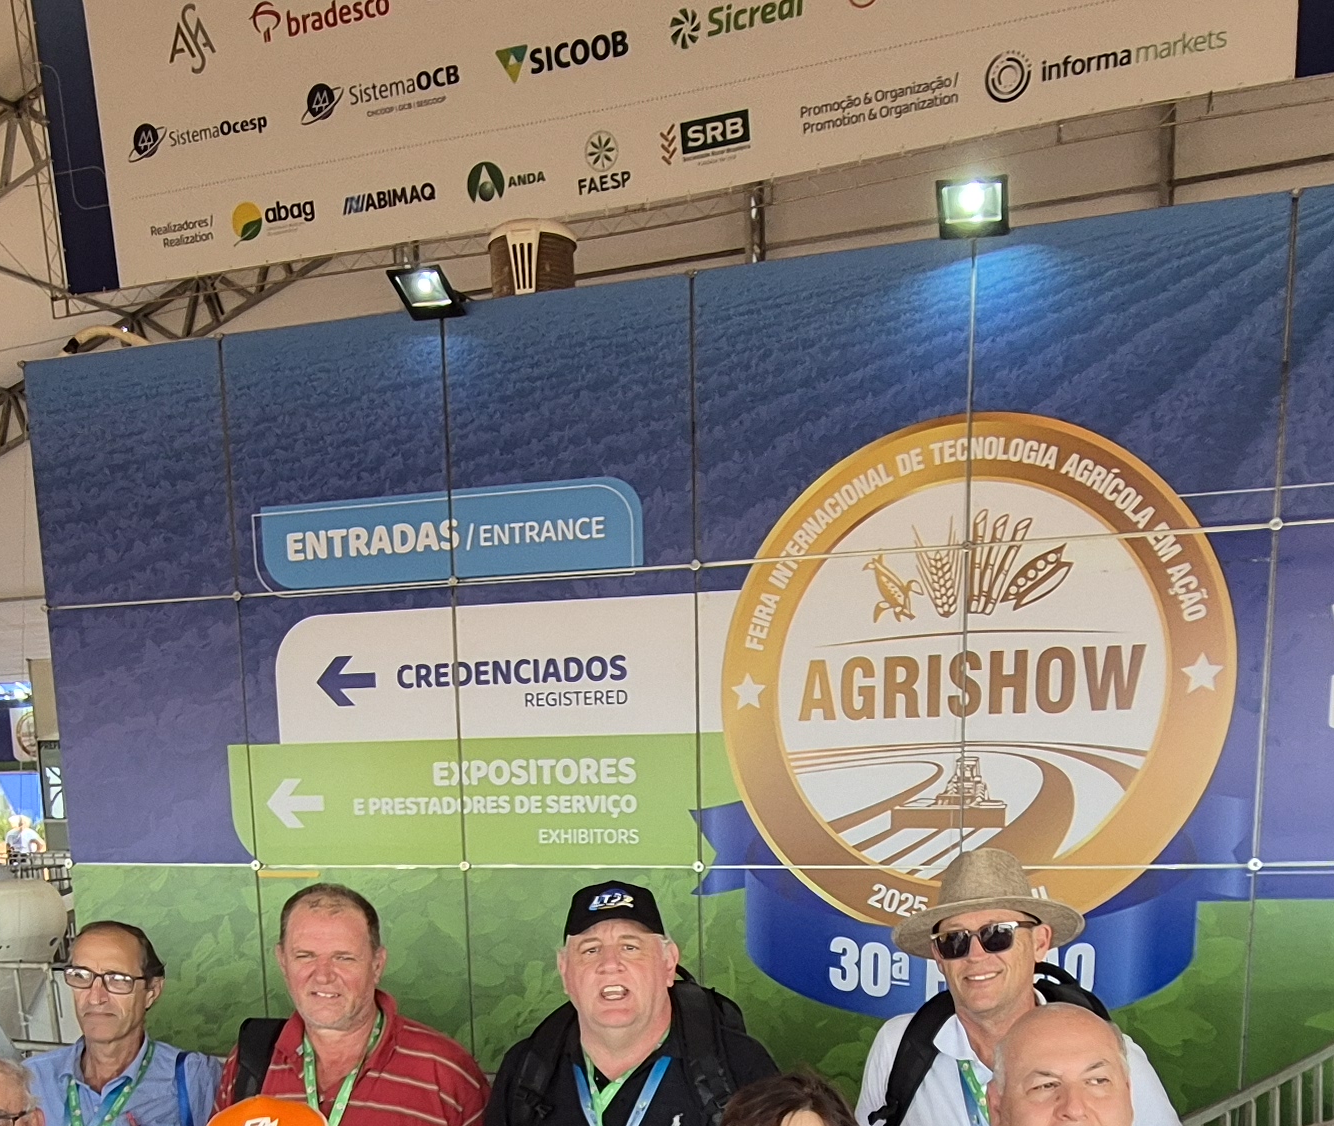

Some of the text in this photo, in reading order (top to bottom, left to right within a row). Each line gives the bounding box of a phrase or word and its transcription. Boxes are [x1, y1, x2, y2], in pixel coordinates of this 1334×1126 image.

[286, 0, 390, 37] bradesco
[529, 30, 629, 75] SICOOB
[800, 95, 861, 118] Promoção
[874, 77, 952, 108] Organização
[802, 111, 866, 134] Promotion
[879, 91, 959, 119] Organization
[686, 116, 744, 148] SRB
[508, 171, 546, 188] ANDA
[577, 170, 631, 196] FAESP
[264, 200, 316, 223] abag
[162, 231, 214, 248] Realization
[285, 518, 460, 562] ENTRADAS
[744, 436, 1208, 651] FEIRA INTERNACIONAL DE TECNOLOGIA AGRÍCOLA EM AÇÃO
[397, 654, 627, 688] CREDENCIADOS
[798, 643, 1148, 722] AGRISHOW
[524, 689, 628, 707] REGISTERED
[432, 757, 637, 787] EXPOSITORES
[353, 795, 637, 818] E PRESTADORES DE SERVIÇO
[538, 828, 639, 845] EXHIBITORS
[867, 883, 929, 916] 2025
